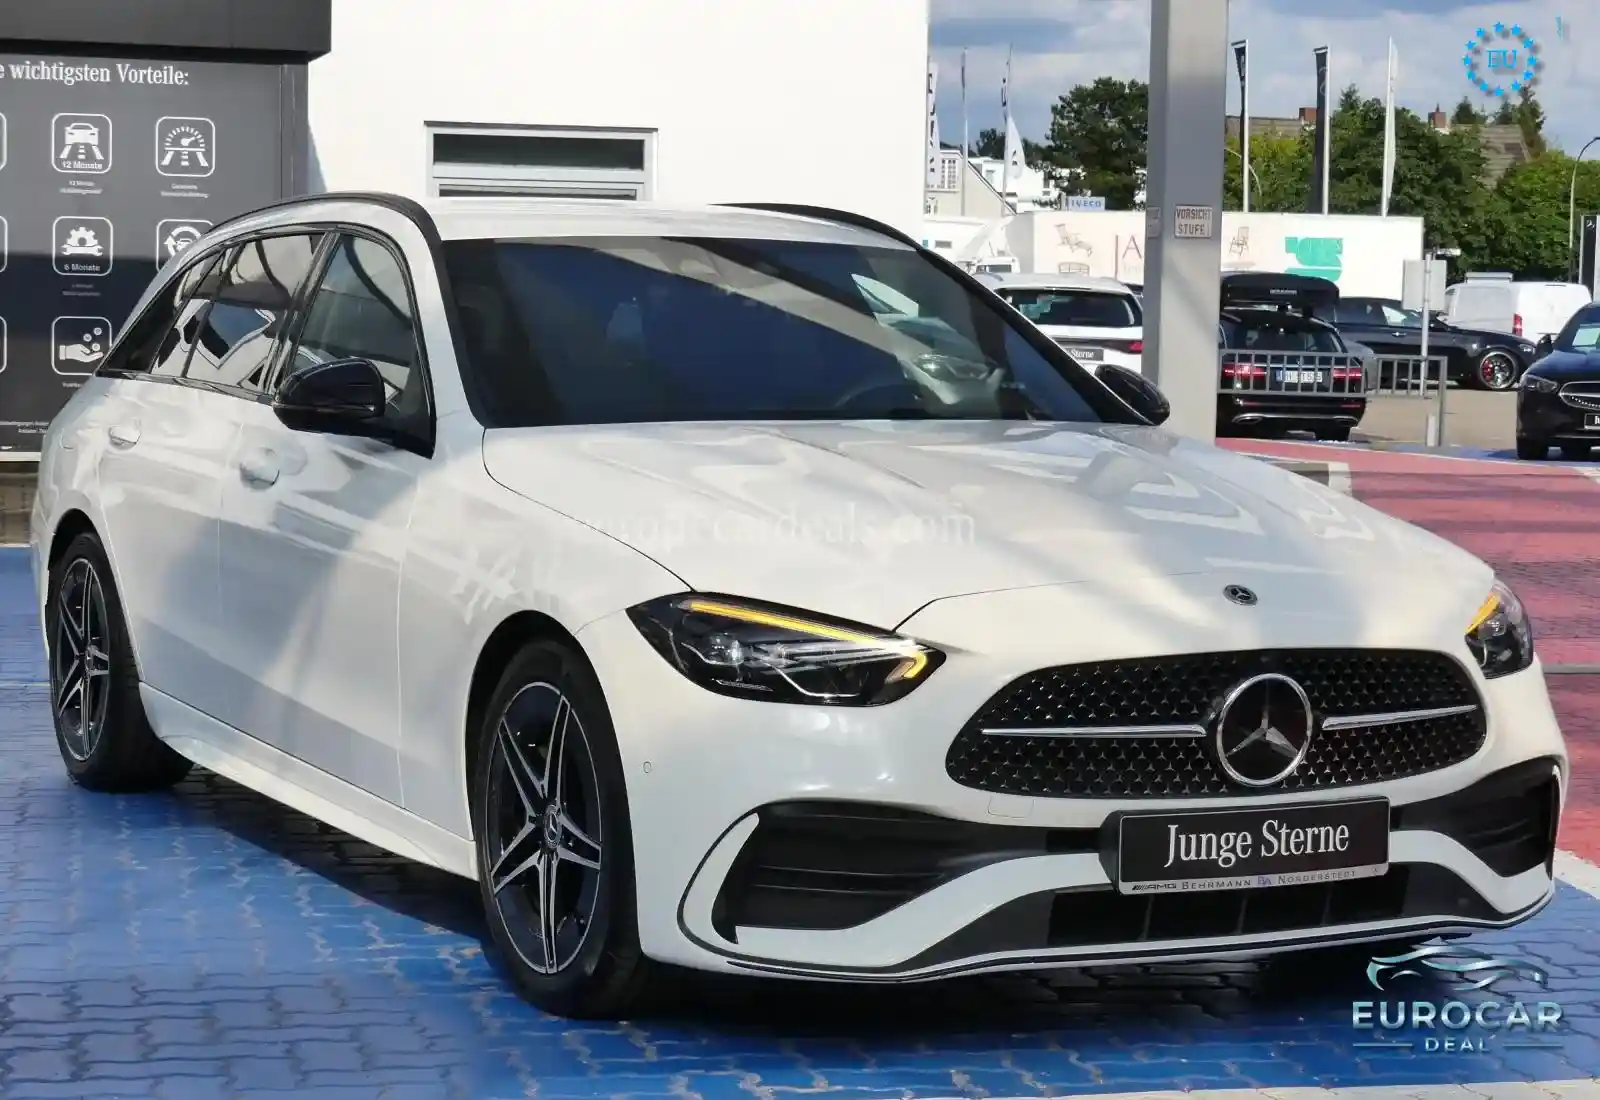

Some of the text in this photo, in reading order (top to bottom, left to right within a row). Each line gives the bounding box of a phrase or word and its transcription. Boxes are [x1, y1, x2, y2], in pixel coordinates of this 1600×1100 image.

[8, 60, 111, 86] wichtigsten
[116, 63, 189, 86] Vorteile:
[1071, 199, 1102, 208] IVECO
[1176, 208, 1212, 220] VORSICHT
[1163, 819, 1350, 868] Junge Sterne
[1181, 879, 1252, 891] BEHRMANN
